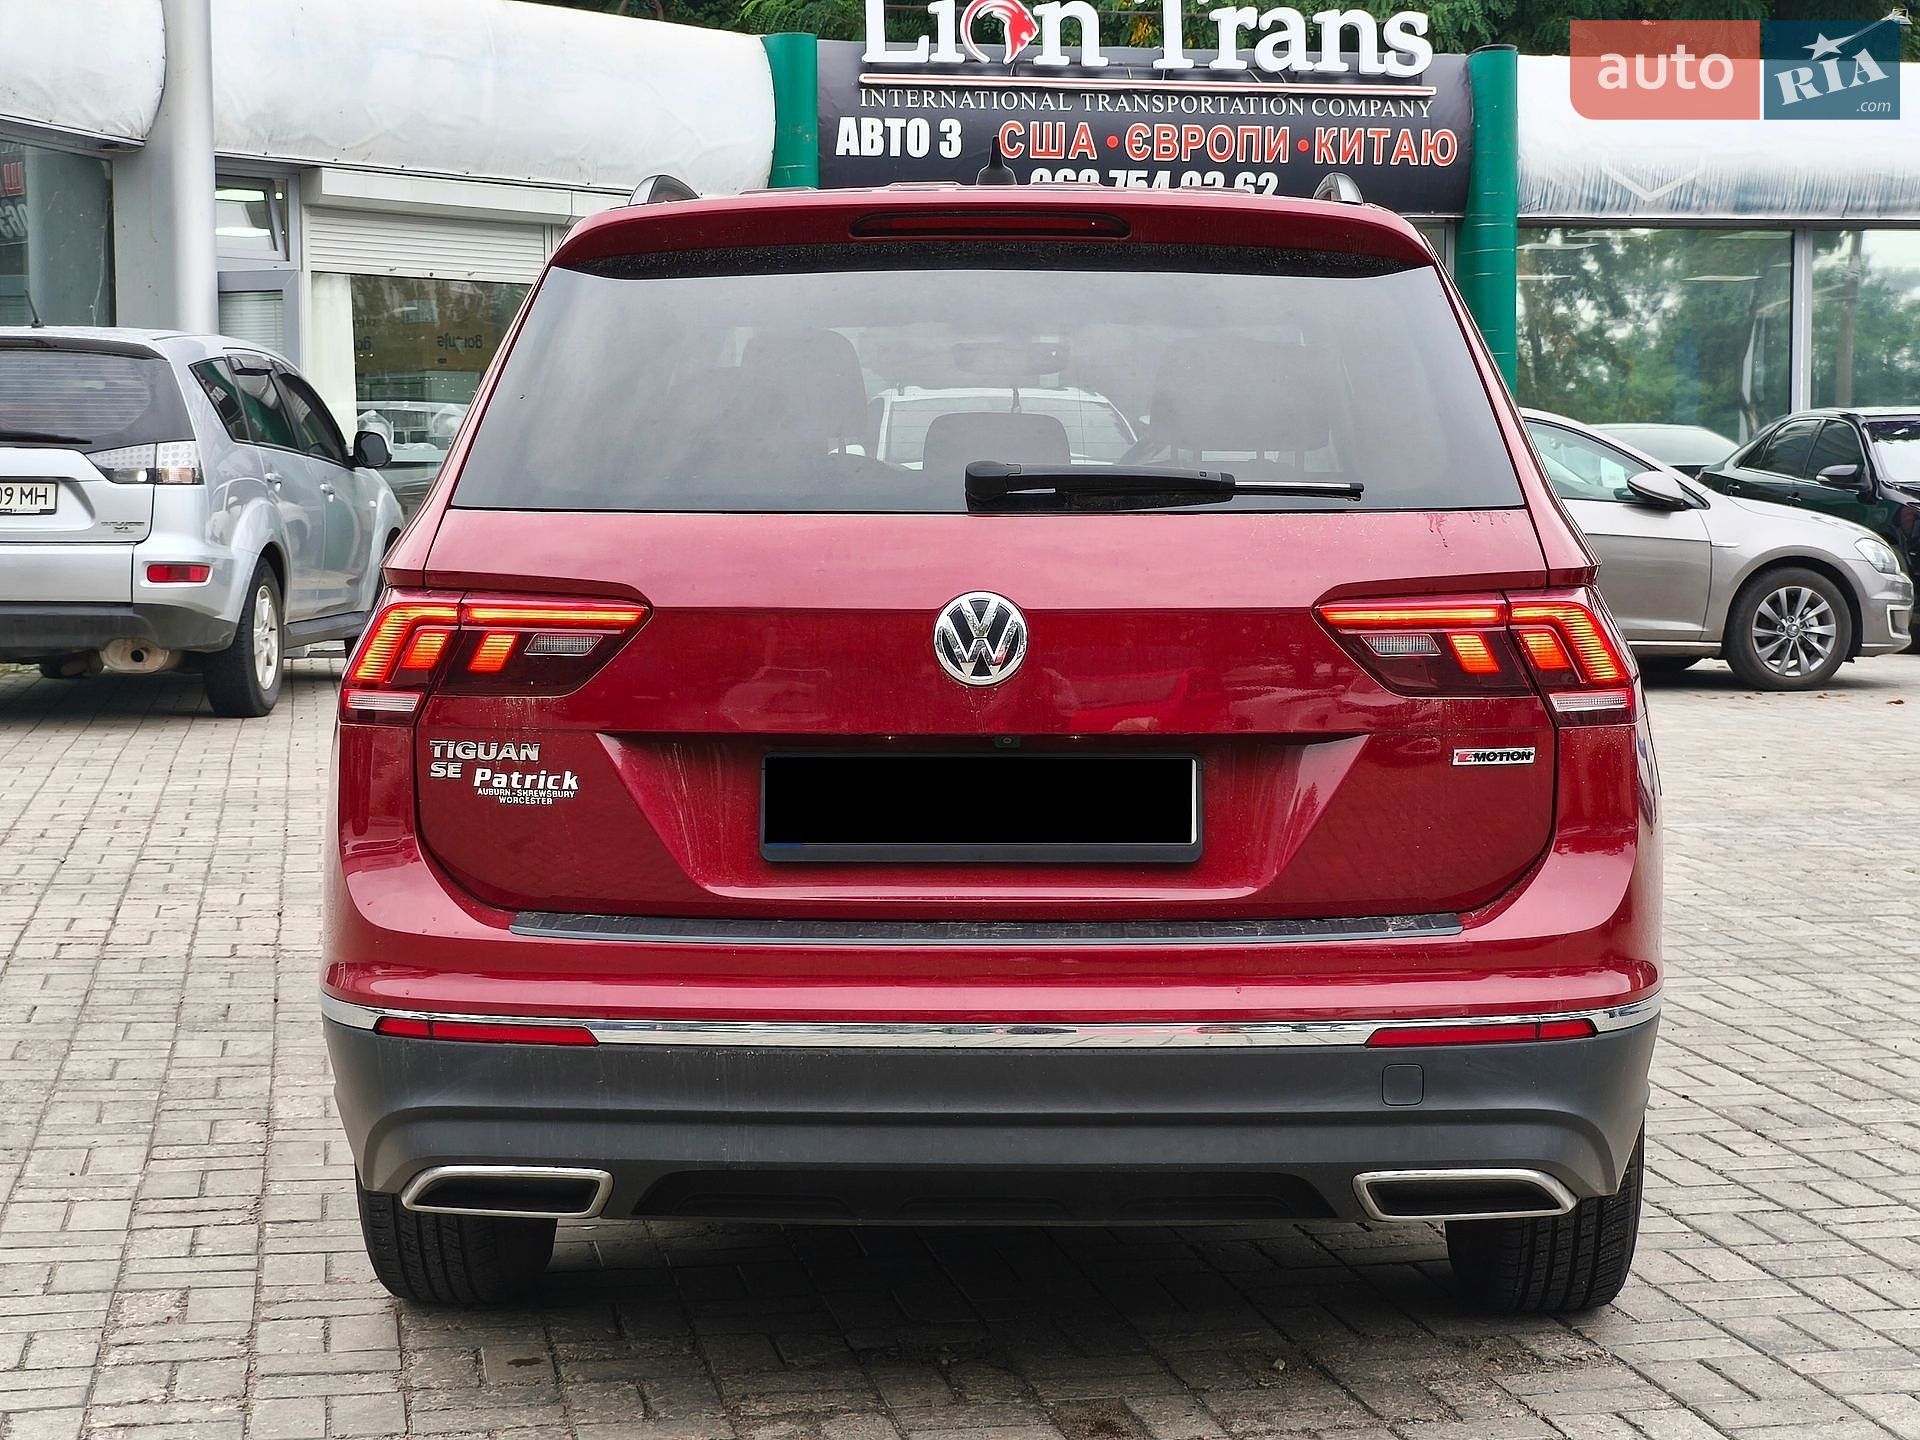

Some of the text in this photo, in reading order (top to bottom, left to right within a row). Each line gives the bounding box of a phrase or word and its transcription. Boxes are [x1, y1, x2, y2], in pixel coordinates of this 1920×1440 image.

[859, 88, 1434, 118] INTERNATIONAL TRANSPORTATION COMPANY
[835, 116, 930, 157] АВТО
[998, 120, 1098, 160] США
[1125, 123, 1290, 163] ЄВРОПИ
[1314, 127, 1458, 167] КИТАЮ
[20, 487, 48, 505] MH
[430, 762, 463, 778] SE
[473, 768, 579, 789] Patrick
[499, 795, 553, 805] WORCESTER
